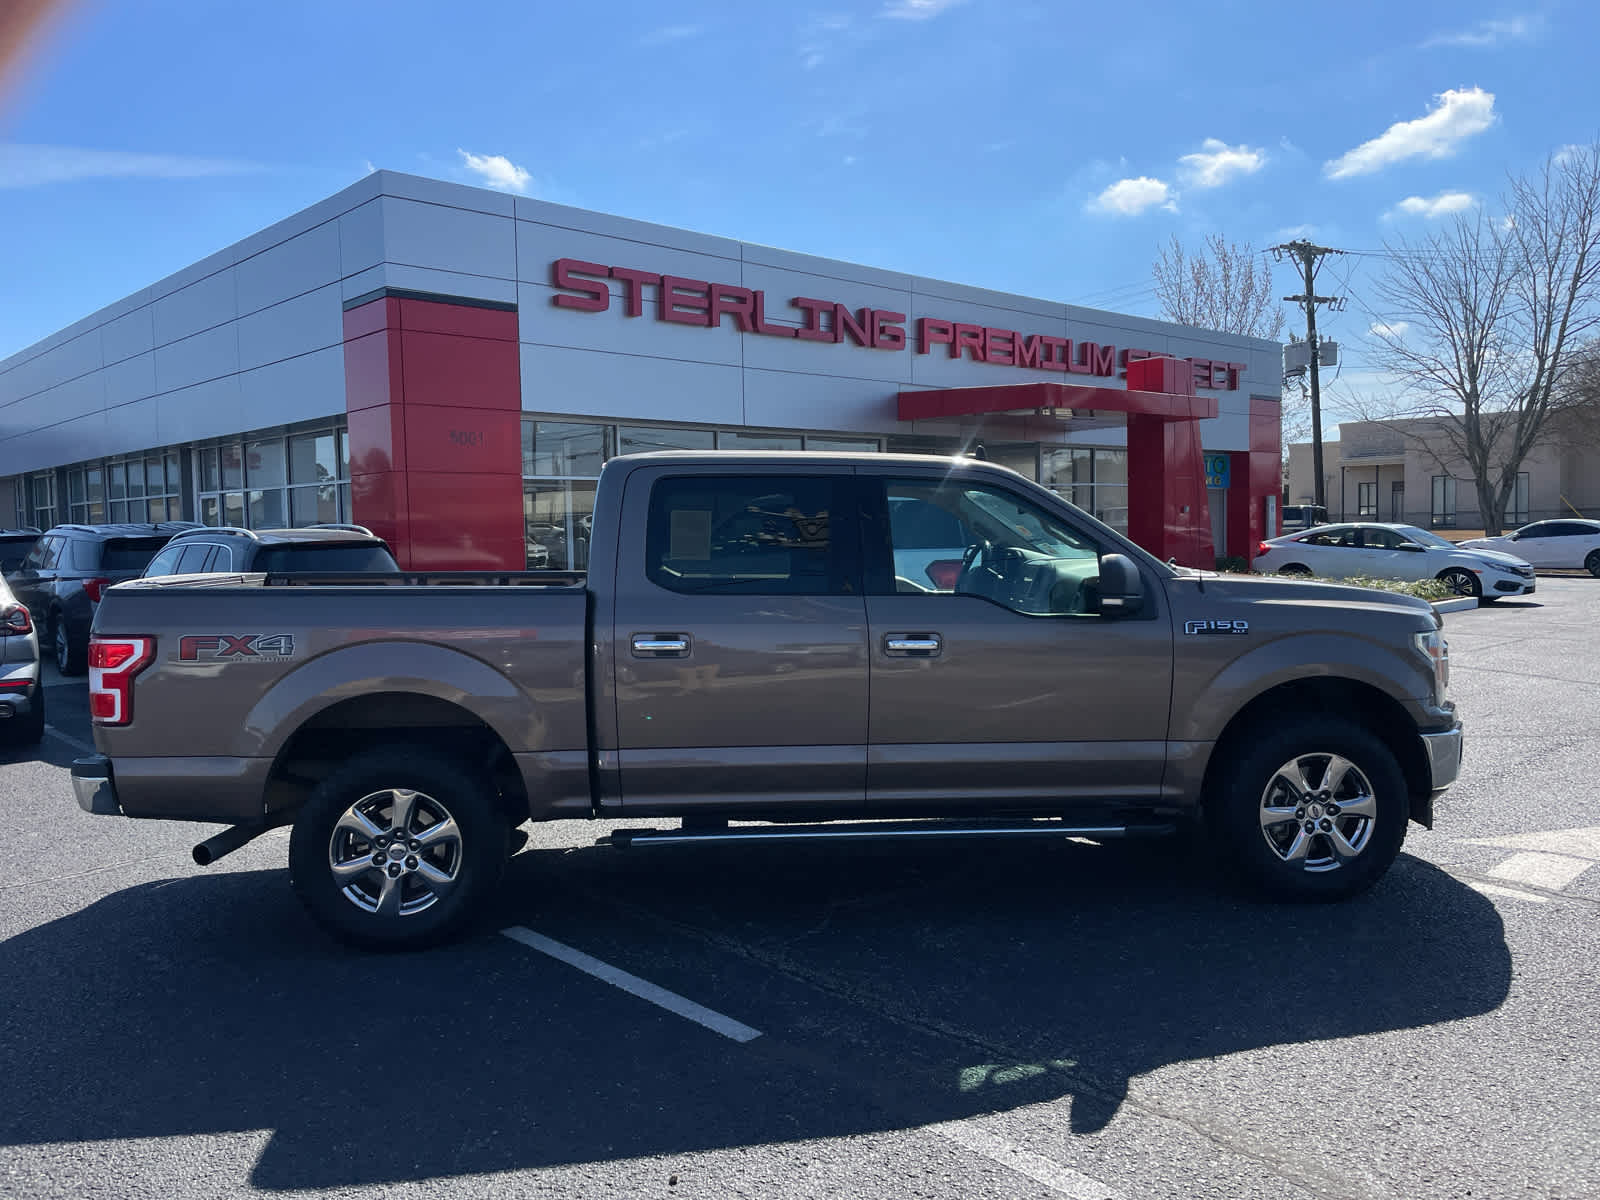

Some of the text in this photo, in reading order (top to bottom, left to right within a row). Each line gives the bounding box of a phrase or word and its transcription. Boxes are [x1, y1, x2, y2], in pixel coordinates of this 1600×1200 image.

[552, 257, 1247, 391] STERLING PREMIUM SECT
[178, 633, 295, 661] FX4
